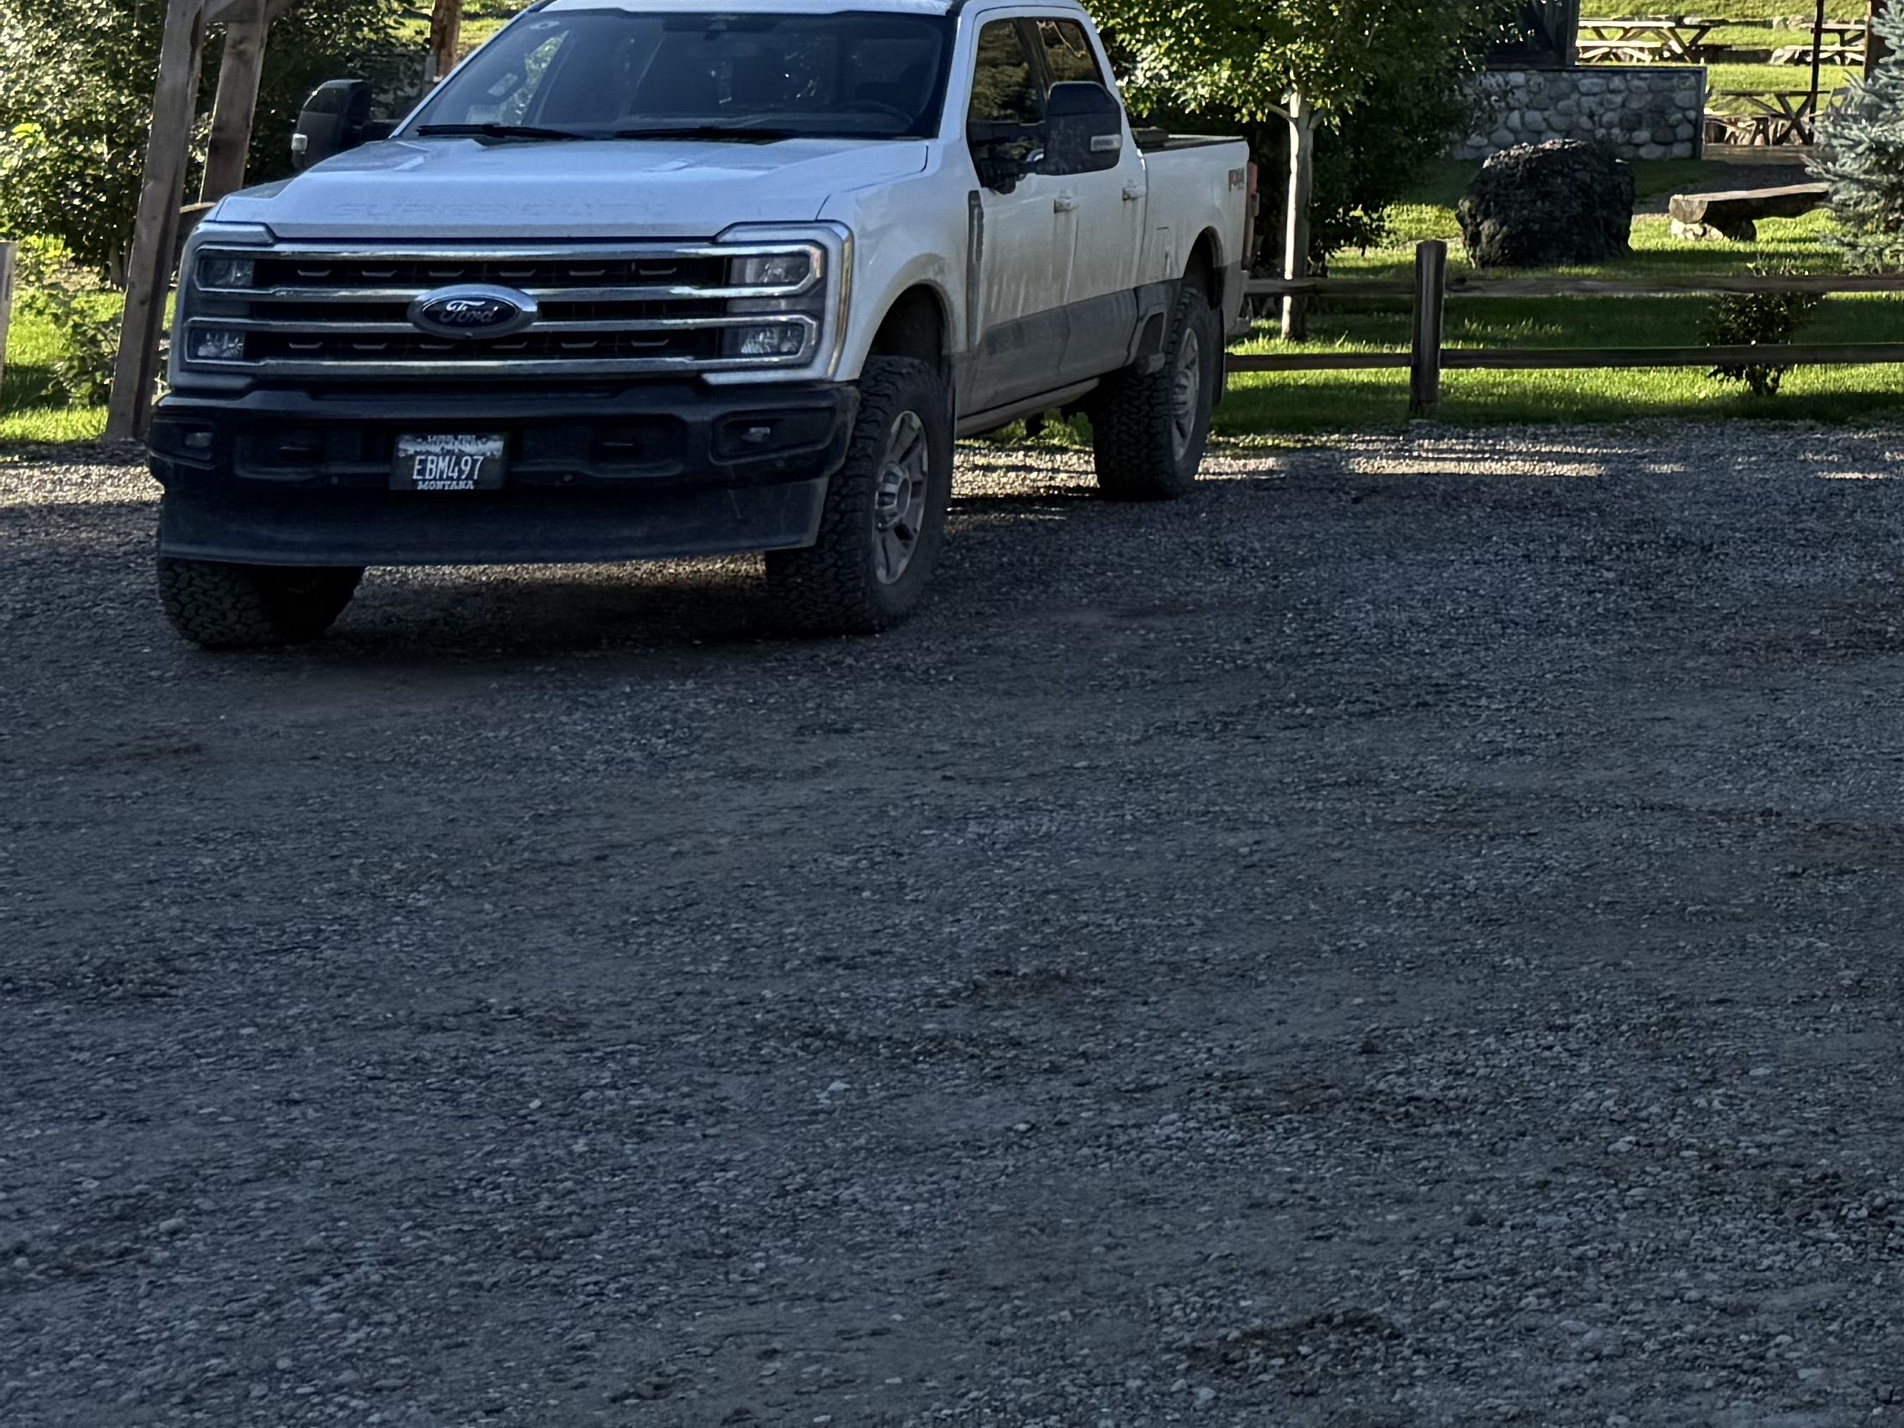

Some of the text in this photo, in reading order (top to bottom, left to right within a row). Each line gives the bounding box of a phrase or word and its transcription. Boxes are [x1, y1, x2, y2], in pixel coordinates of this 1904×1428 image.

[440, 299, 499, 323] Ford
[412, 455, 484, 480] EBM497
[416, 480, 474, 490] MONTANA
